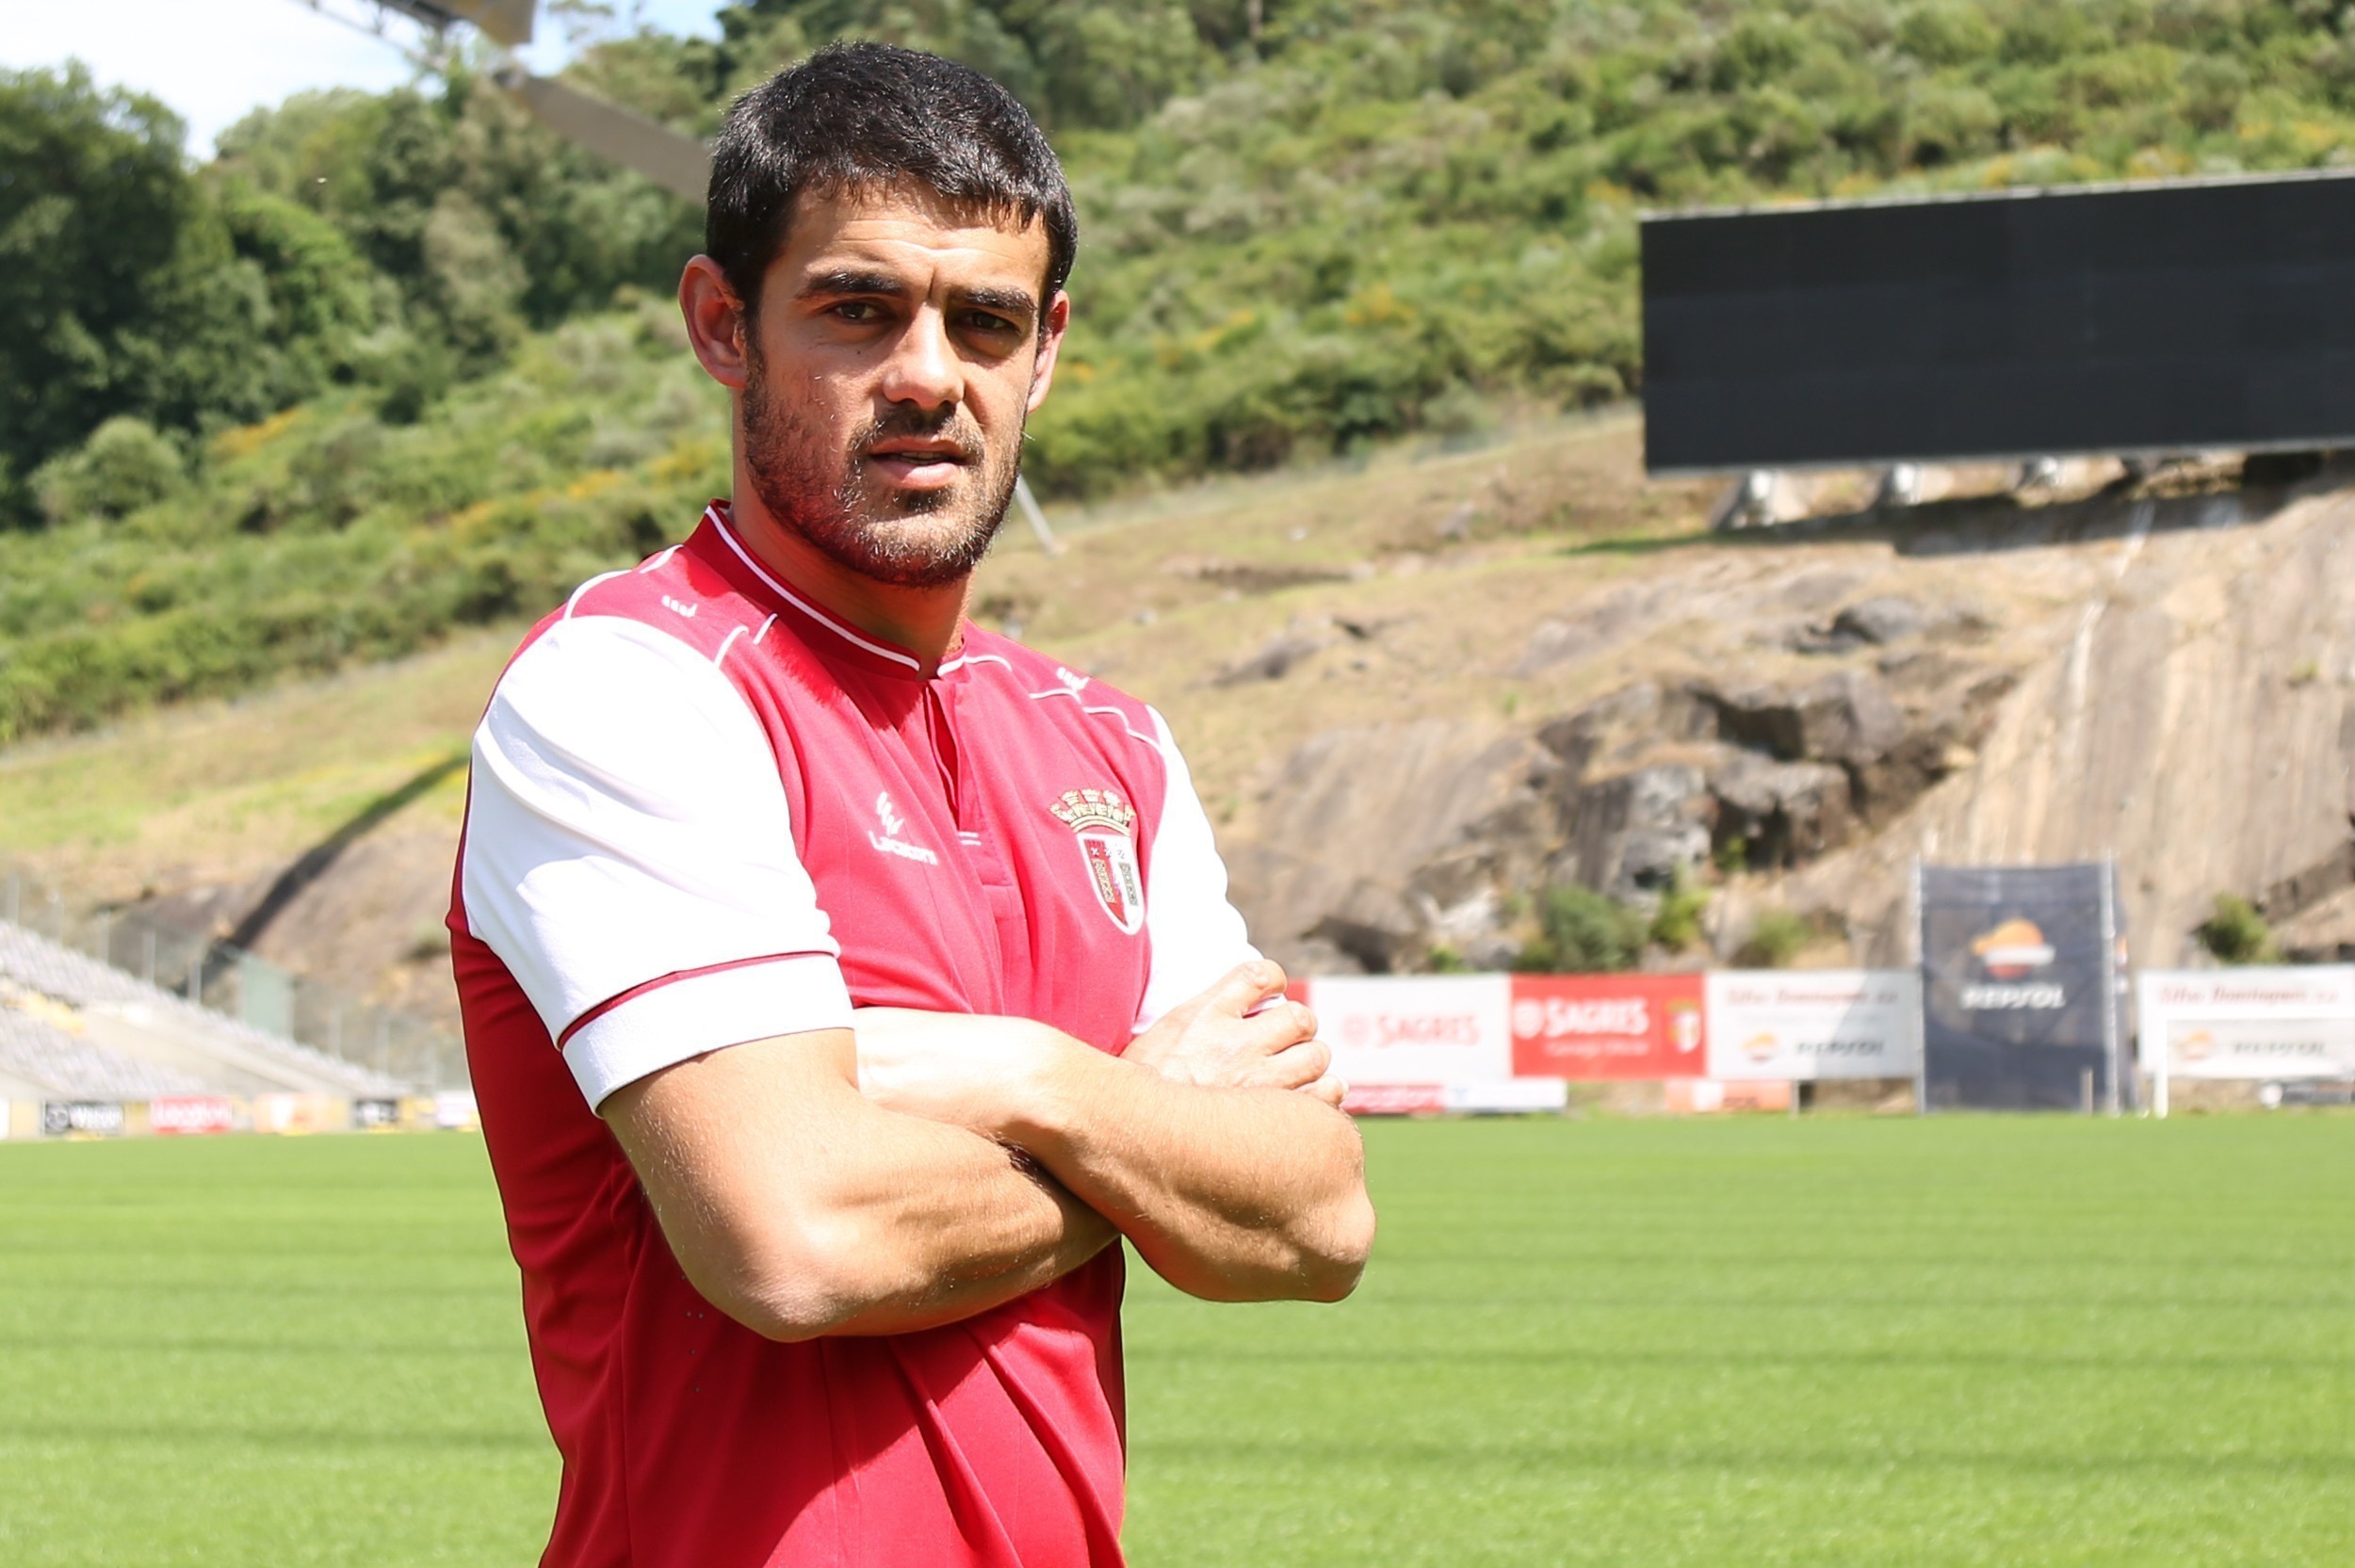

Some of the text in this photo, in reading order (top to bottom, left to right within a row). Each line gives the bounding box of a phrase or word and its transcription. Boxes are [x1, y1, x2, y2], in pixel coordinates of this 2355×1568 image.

[1962, 984, 2066, 1009] REPSOL
[1378, 1015, 1480, 1047] SAGRES
[1545, 998, 1649, 1037] SAGRES
